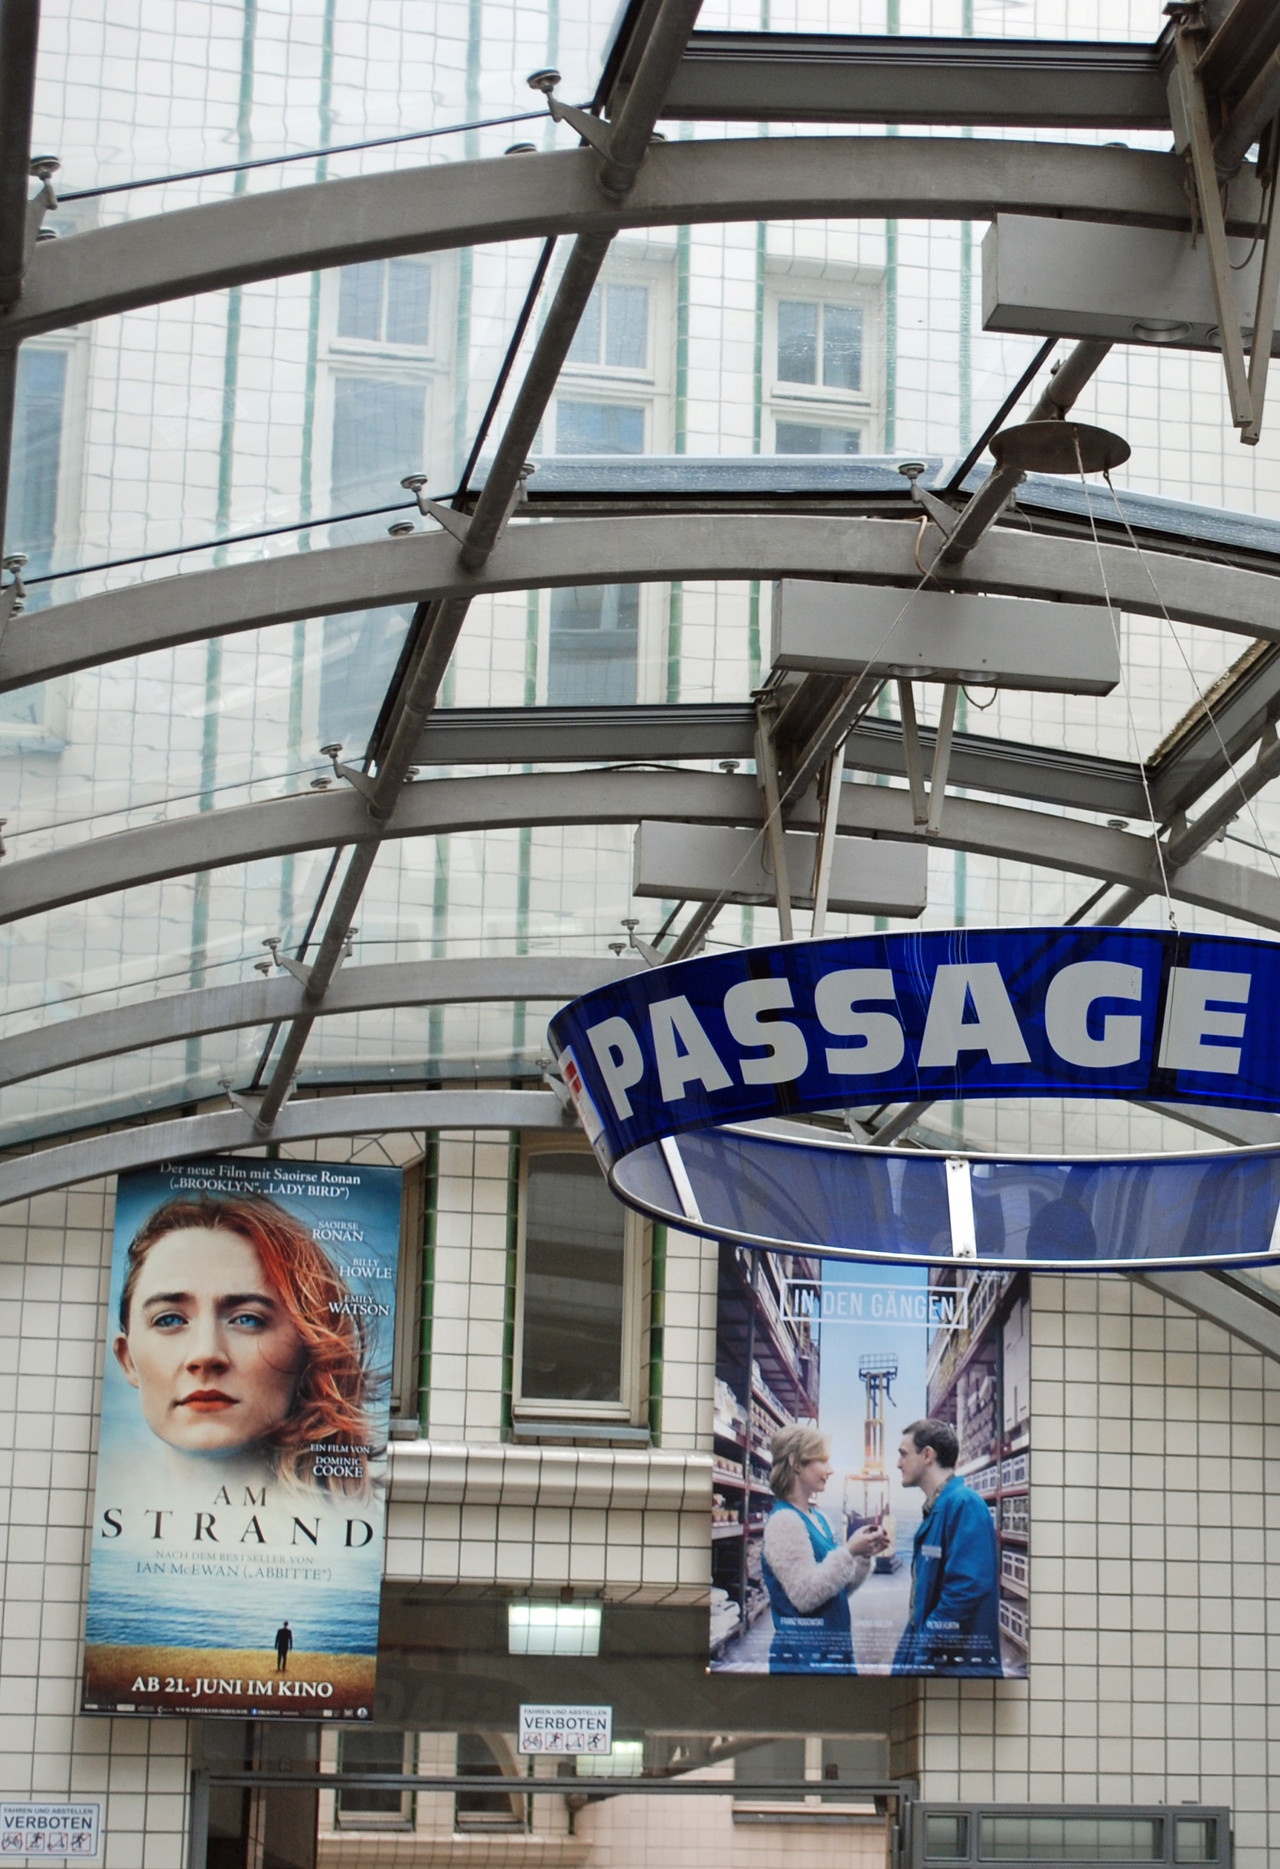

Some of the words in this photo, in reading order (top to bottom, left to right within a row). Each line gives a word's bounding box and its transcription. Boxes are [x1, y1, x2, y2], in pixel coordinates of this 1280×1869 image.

[586, 960, 1253, 1121] PASSAGE
[187, 1167, 216, 1176] neue
[219, 1164, 247, 1178] Film
[250, 1168, 271, 1180] mit
[273, 1168, 318, 1183] Saoirse
[320, 1170, 361, 1185] Ronan
[318, 1220, 359, 1230] SAOIRSE
[312, 1228, 364, 1242] RONAN
[352, 1258, 380, 1267] BILLY
[339, 1265, 392, 1279] HOWLE
[344, 1294, 375, 1304] EMILY
[794, 1288, 815, 1315] IN
[823, 1290, 863, 1317] DEN
[871, 1289, 954, 1321] GÄNGEN
[328, 1301, 390, 1316] WATSON
[310, 1443, 327, 1452] EIN
[328, 1444, 349, 1453] FILM
[350, 1446, 371, 1455] VON
[315, 1456, 362, 1466] DOMINIC
[312, 1465, 364, 1478] COOKE
[213, 1485, 267, 1507] AM
[101, 1508, 375, 1548] STRAND
[156, 1550, 189, 1561] NACH
[191, 1551, 217, 1562] DEM
[219, 1552, 286, 1565] BESTSELLER
[288, 1554, 315, 1565] VON
[136, 1561, 166, 1575] IAN
[170, 1562, 239, 1578] McEWAN
[131, 1676, 161, 1692] AB
[164, 1677, 191, 1693] 21.
[191, 1677, 243, 1698] JUNI
[247, 1679, 273, 1696] IM
[278, 1680, 334, 1698] KINO
[524, 1717, 607, 1730] VERBOTEN
[4, 1815, 92, 1830] VERBOTEN
